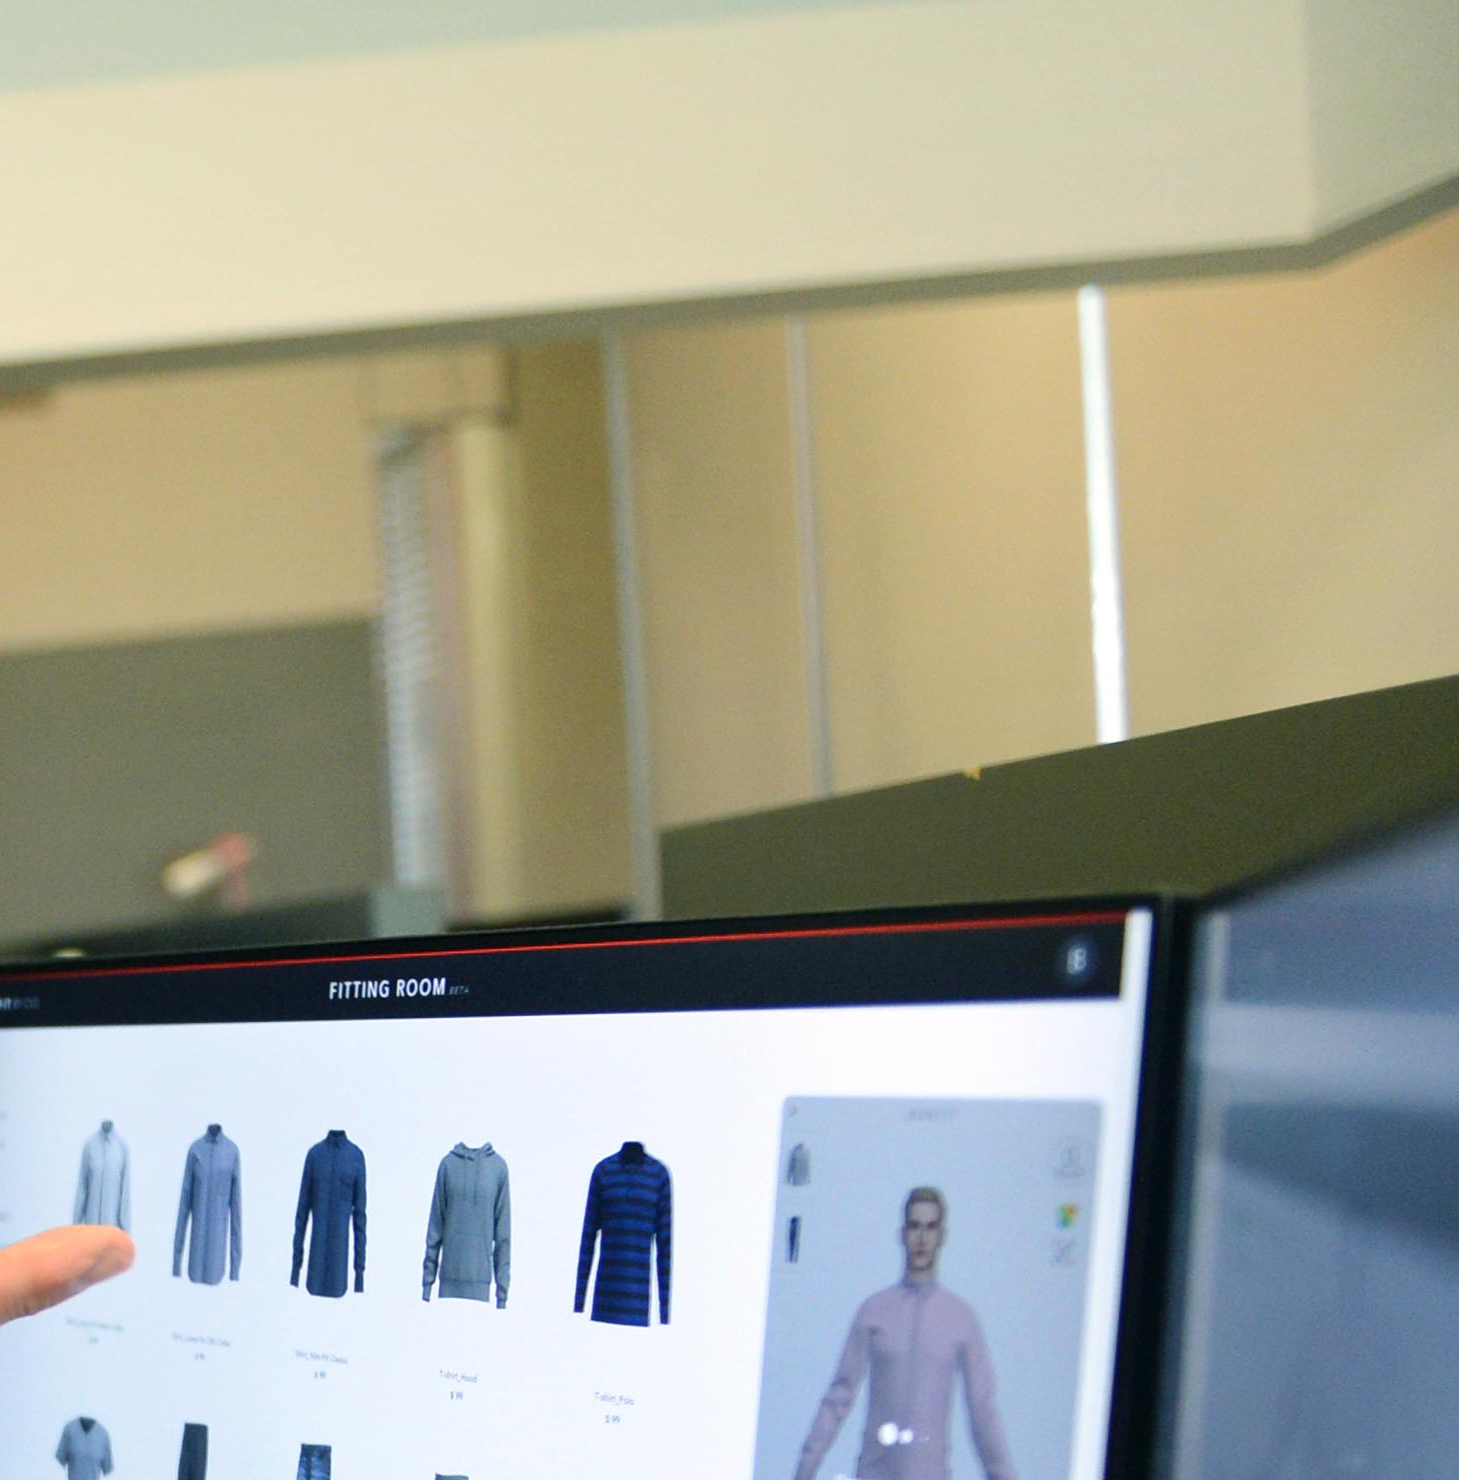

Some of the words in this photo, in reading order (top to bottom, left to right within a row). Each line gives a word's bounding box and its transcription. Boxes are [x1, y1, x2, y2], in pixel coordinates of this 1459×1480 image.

[329, 980, 390, 1000] FITTING
[396, 977, 446, 998] ROOM
[449, 986, 469, 995] BETA
